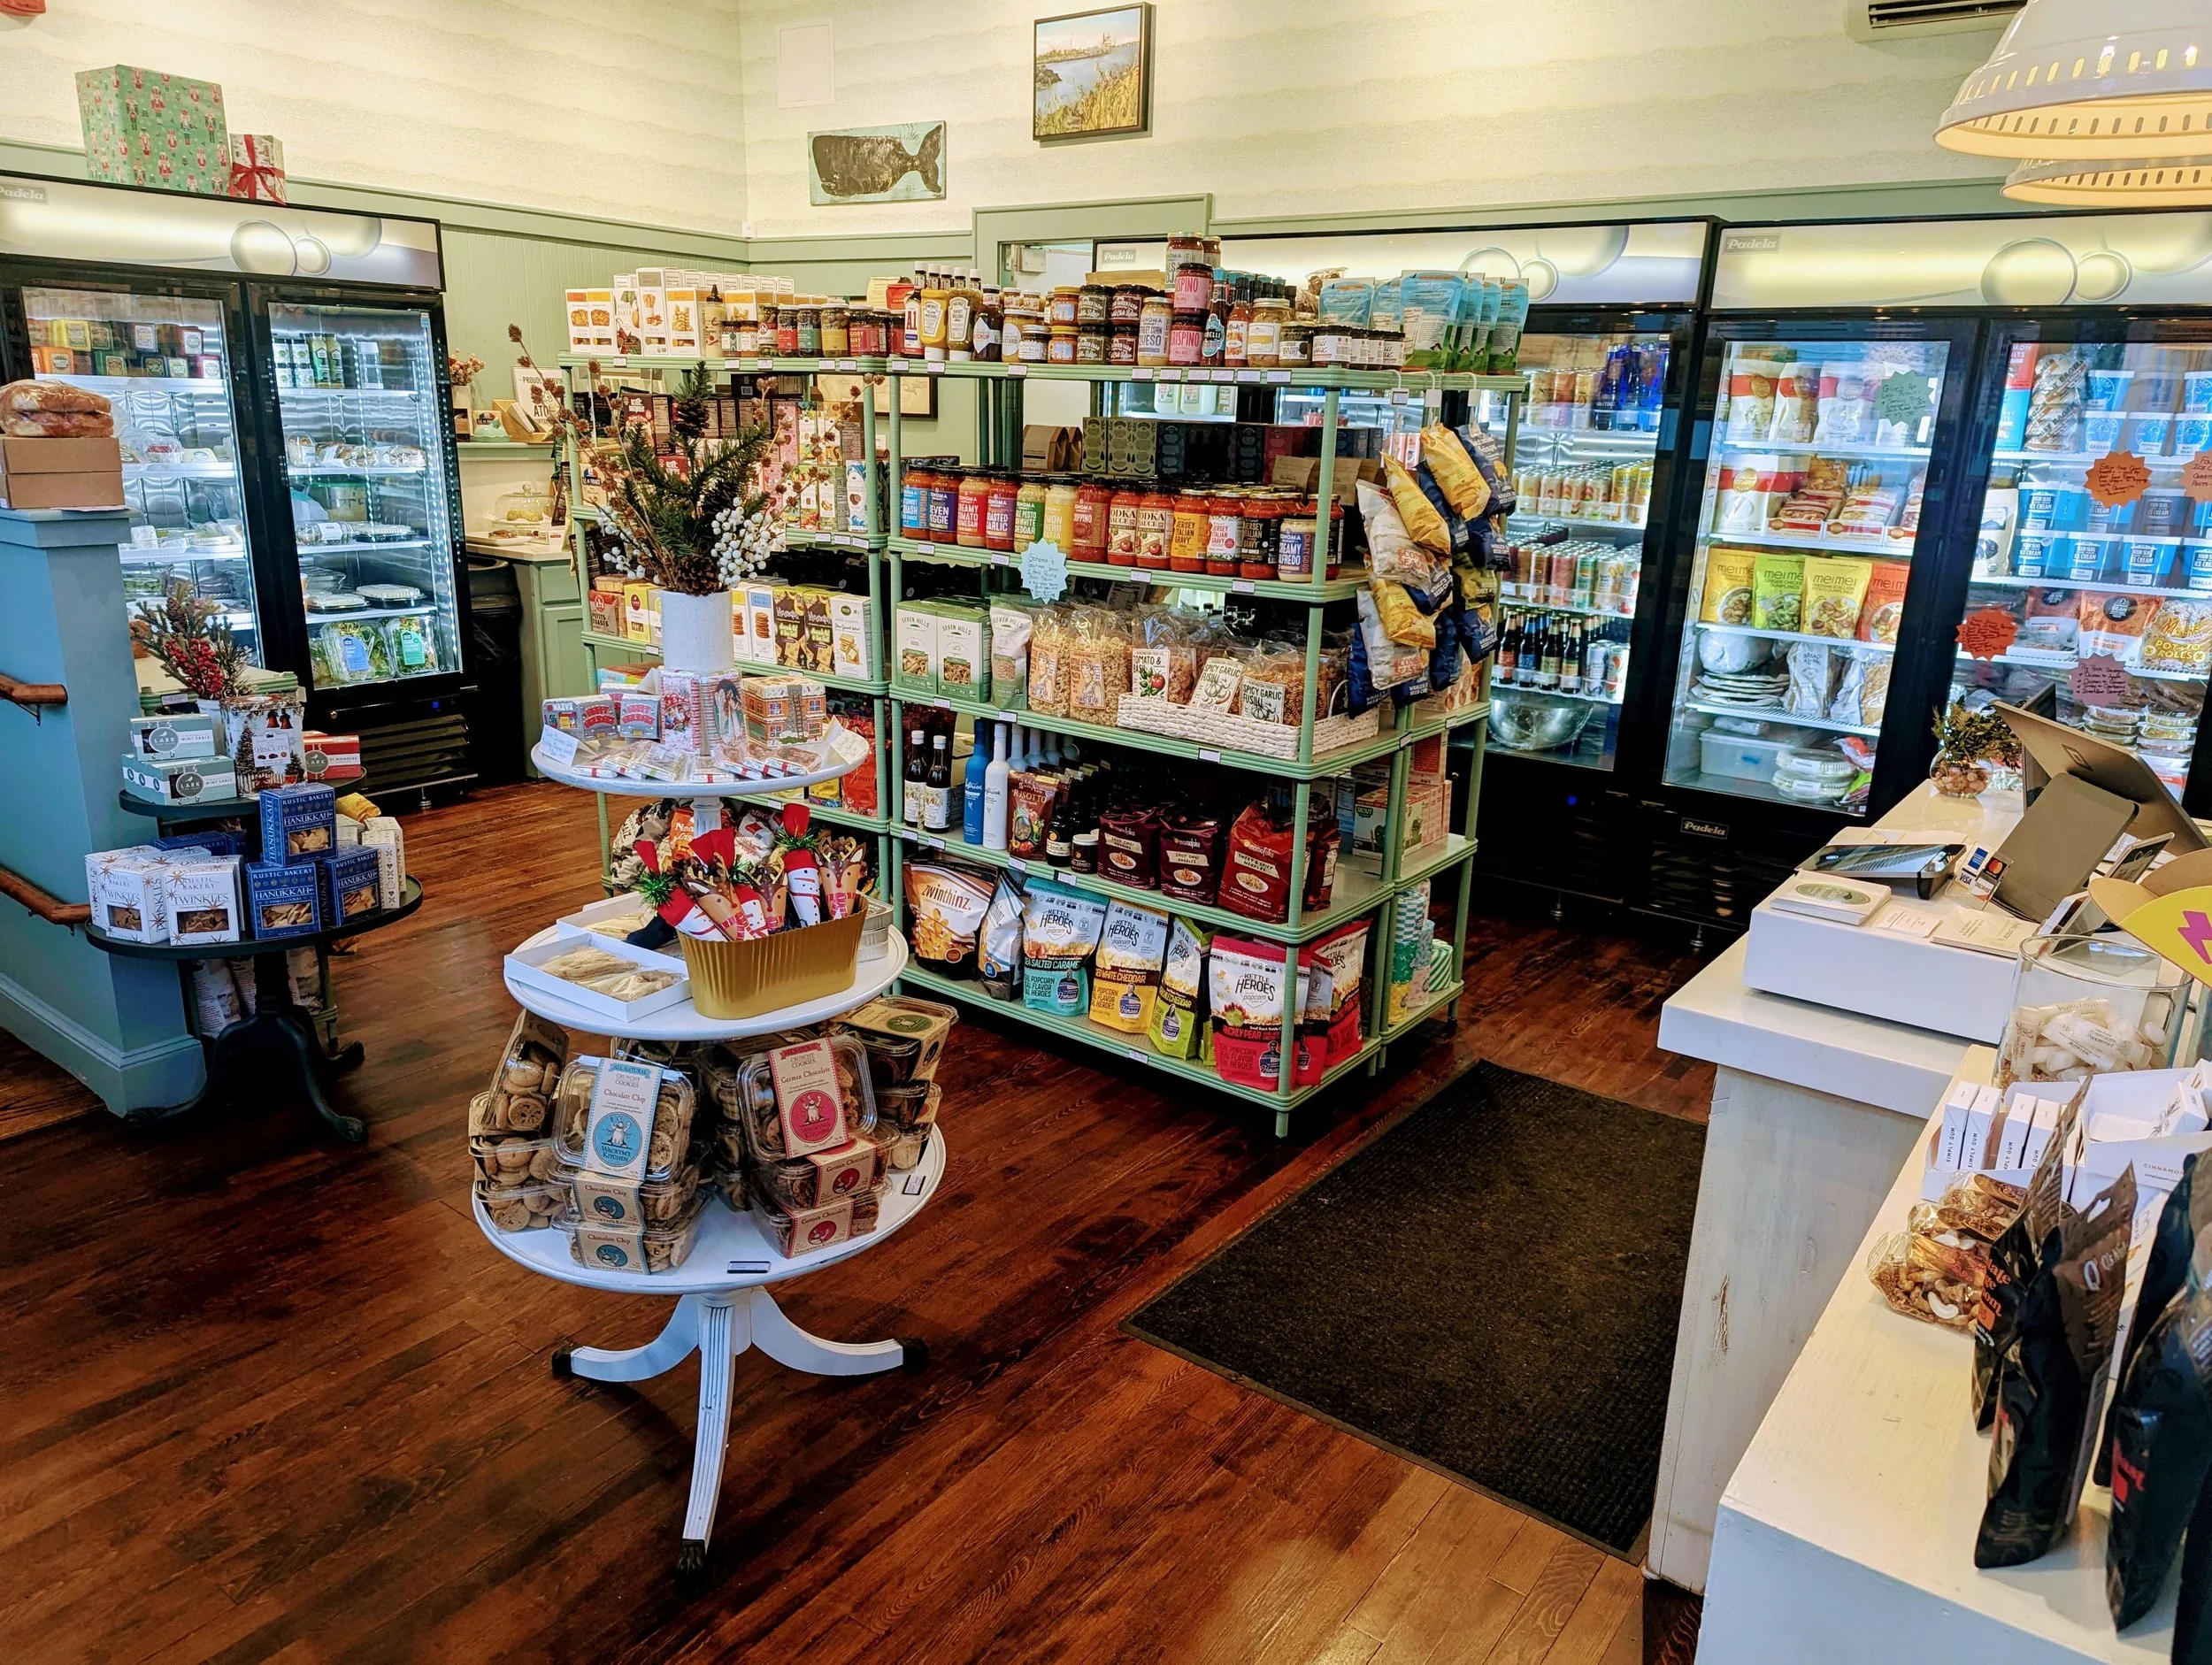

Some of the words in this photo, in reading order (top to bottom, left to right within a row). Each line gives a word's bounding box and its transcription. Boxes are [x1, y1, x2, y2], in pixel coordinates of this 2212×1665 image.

[1726, 238, 1777, 249] Padela
[1103, 250, 1133, 260] Padela
[1176, 521, 1195, 532] JERSEY
[1175, 529, 1194, 538] ITALIAN
[1175, 536, 1192, 545] GRAVY
[1717, 564, 1755, 576] meime
[1764, 569, 1803, 581] meime
[1814, 574, 1856, 587] meimei
[1873, 577, 1906, 589] meim
[902, 615, 915, 625] SEVEN
[916, 618, 930, 629] HILLS
[1010, 618, 1025, 630] HILLS
[956, 627, 972, 636] HILLS
[1204, 664, 1218, 673] SPICY
[1218, 666, 1241, 679] GARLIC
[1243, 685, 1260, 695] SPICY
[1260, 689, 1282, 700] GARLIC
[309, 793, 333, 802] BAKERY
[1011, 789, 1048, 803] RISOTTO
[284, 811, 330, 825] HANUKKAH
[265, 798, 276, 863] HANUKKAH
[1114, 825, 1136, 837] momofuku
[1684, 821, 1726, 835] Padela
[1179, 838, 1201, 849] momofuku
[1248, 844, 1274, 858] momofuku
[336, 858, 357, 867] RUSTIC
[357, 852, 377, 863] BAKERY
[1239, 853, 1254, 862] SWEET
[1244, 861, 1265, 871] NOODLES
[253, 871, 283, 879] RUSTIC
[338, 872, 376, 888] HANUKKAH
[1960, 873, 1972, 885] VISA
[105, 890, 141, 902] TWINKLES
[174, 894, 230, 905] TWINKLES
[255, 887, 311, 900] HANUKKAH
[154, 878, 166, 932] TWINKLES
[1048, 909, 1071, 919] KETTLE
[1040, 913, 1074, 935] HEROES
[1116, 919, 1136, 930] KETTLE
[1107, 924, 1140, 947] HEROES
[1032, 958, 1052, 969] SALTED
[1029, 975, 1055, 985] POPCORN
[1102, 971, 1117, 980] WHITE
[1117, 972, 1146, 984] CHEDDAR
[1244, 973, 1270, 982] KETTLE
[1098, 986, 1118, 996] POPCORN
[1235, 978, 1275, 1002] HEROES
[1095, 1001, 1115, 1010] HEROES
[1243, 1030, 1262, 1040] PEAR
[1231, 1047, 1257, 1056] POPCORN
[790, 1053, 814, 1063] CRUNCHY
[792, 1059, 816, 1069] COOKIES
[1230, 1053, 1254, 1063] FLAVOR
[627, 1065, 649, 1074] NATURAL
[1230, 1061, 1254, 1070] HEROES
[780, 1073, 803, 1084] German
[803, 1066, 831, 1079] Chocolate
[603, 1089, 631, 1100] Chocolate
[632, 1093, 646, 1103] Chip
[603, 1153, 629, 1162] KITCHEN
[826, 1162, 846, 1172] German
[846, 1154, 871, 1166] Chocolate
[585, 1185, 611, 1194] Chocolate
[612, 1188, 627, 1197] Chip
[822, 1208, 848, 1220] Chocolate
[588, 1233, 615, 1243] Chocolate
